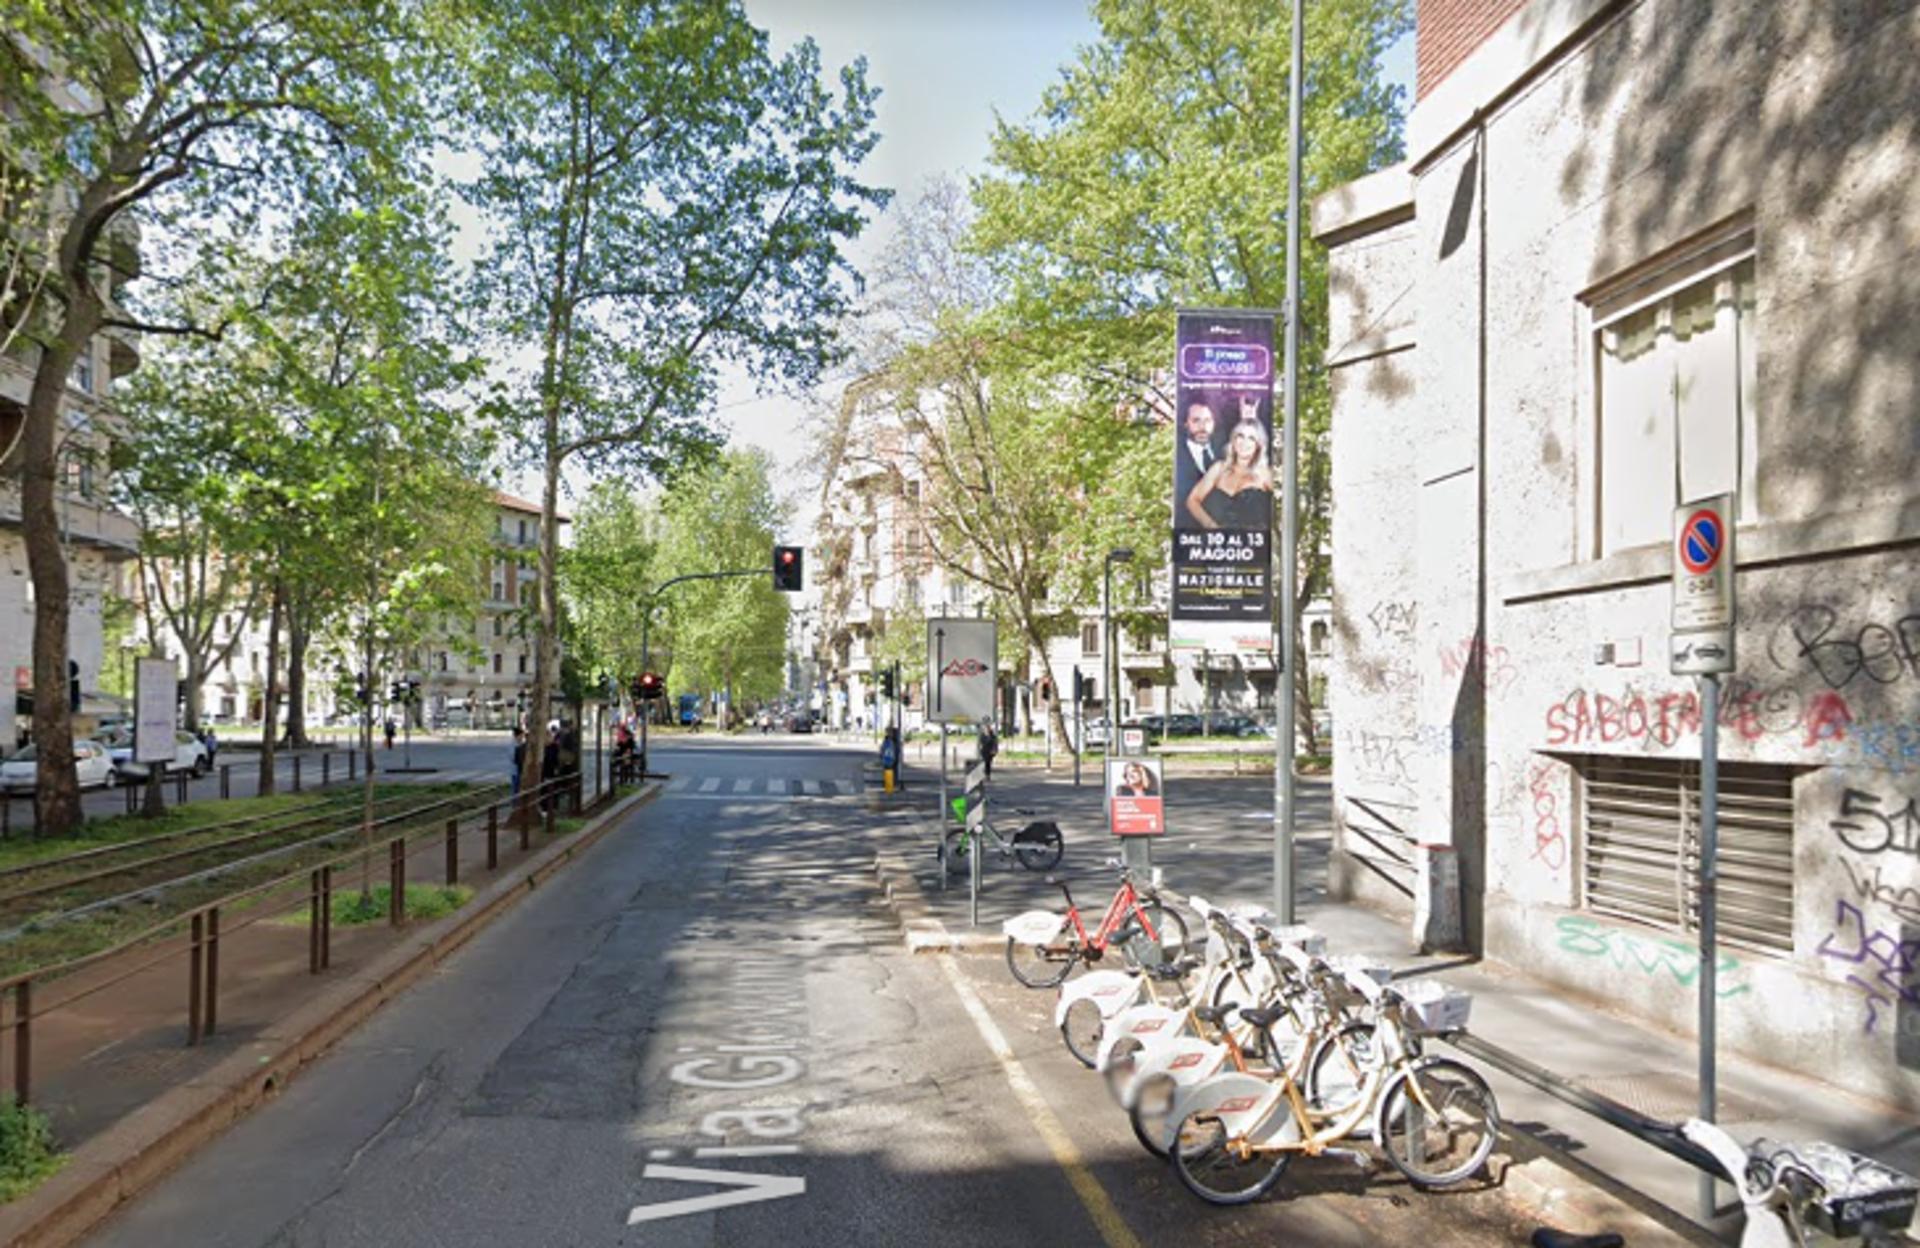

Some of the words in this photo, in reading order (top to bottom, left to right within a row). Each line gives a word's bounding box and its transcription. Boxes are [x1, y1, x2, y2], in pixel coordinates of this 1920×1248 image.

[1179, 534, 1202, 546] DAL
[1206, 533, 1225, 546] 10
[1226, 535, 1243, 546] AL
[1247, 532, 1265, 546] 13
[1189, 548, 1254, 561] MAGGIO
[1178, 574, 1265, 587] NAZIONALE
